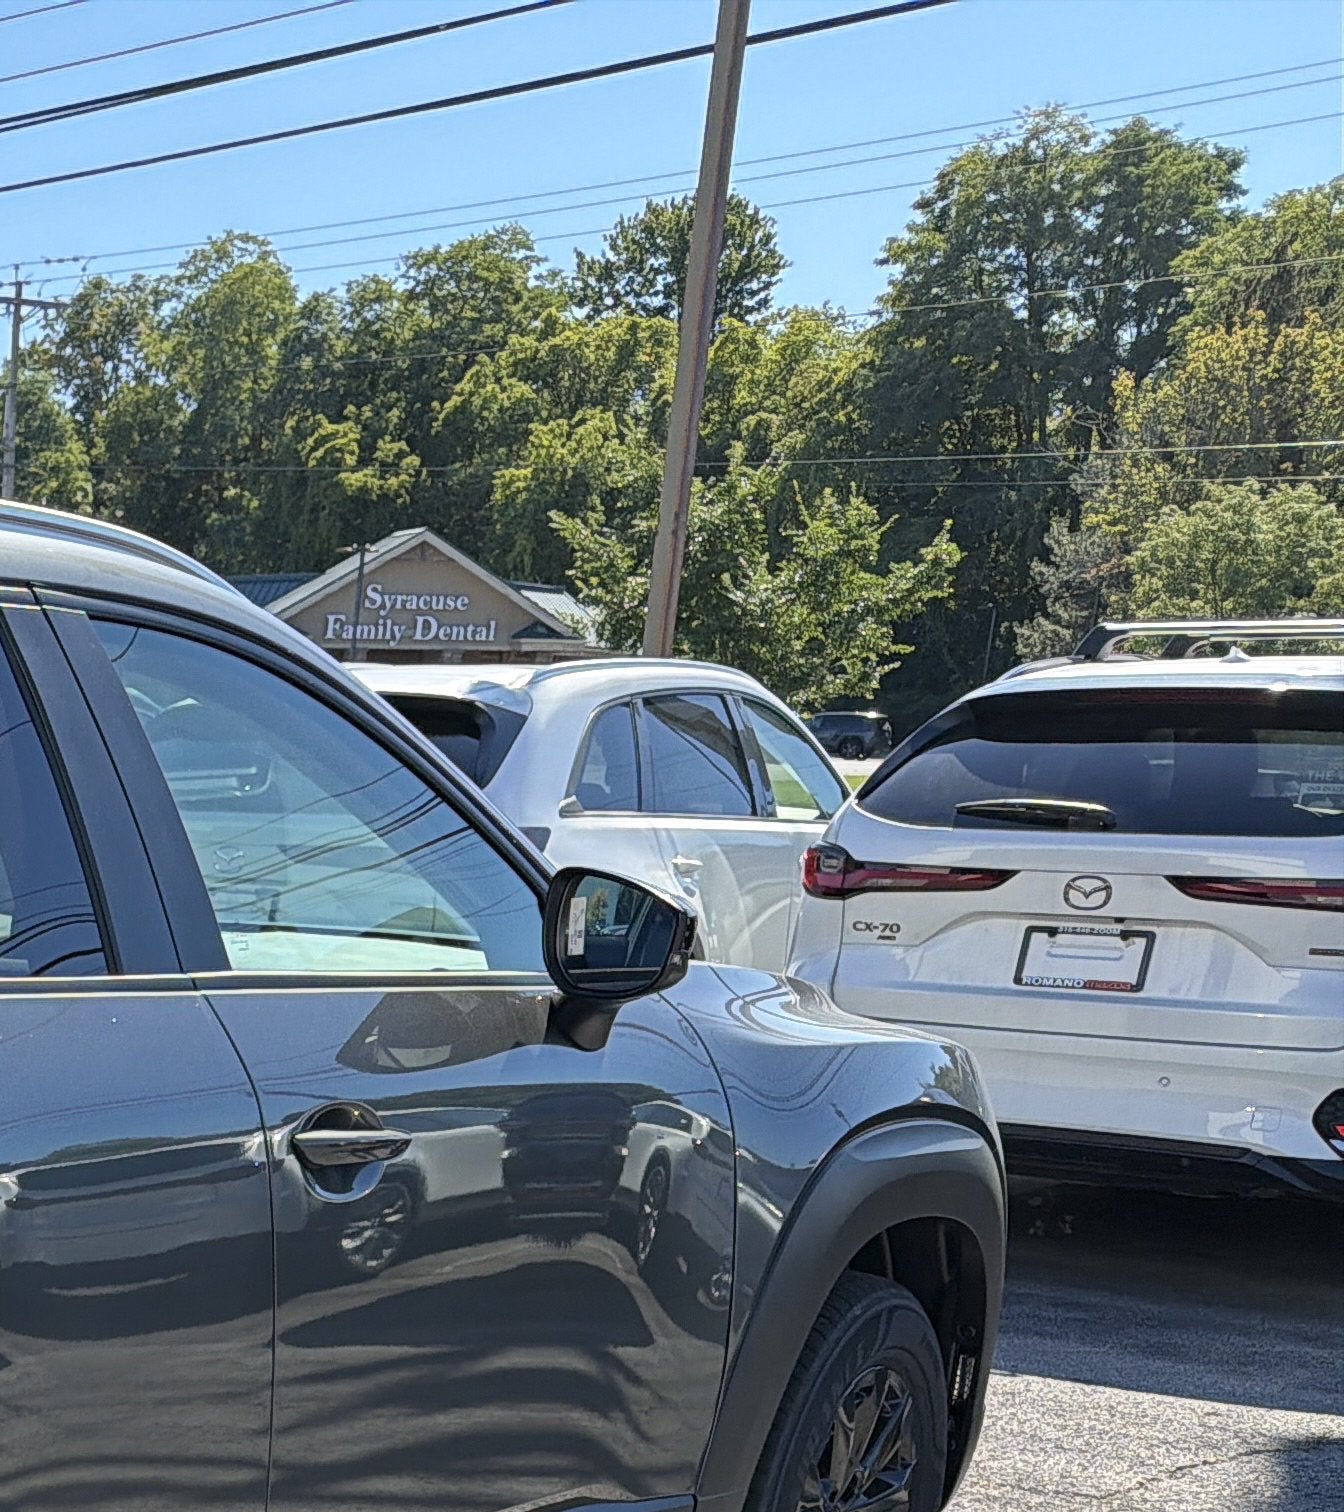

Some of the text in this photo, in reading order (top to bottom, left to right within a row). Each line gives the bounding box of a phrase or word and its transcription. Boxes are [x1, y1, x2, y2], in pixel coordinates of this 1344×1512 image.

[364, 584, 469, 616] Syracuse
[324, 615, 497, 647] Family Dental
[852, 921, 901, 933] CX-70
[1022, 976, 1085, 988] ROMANO
